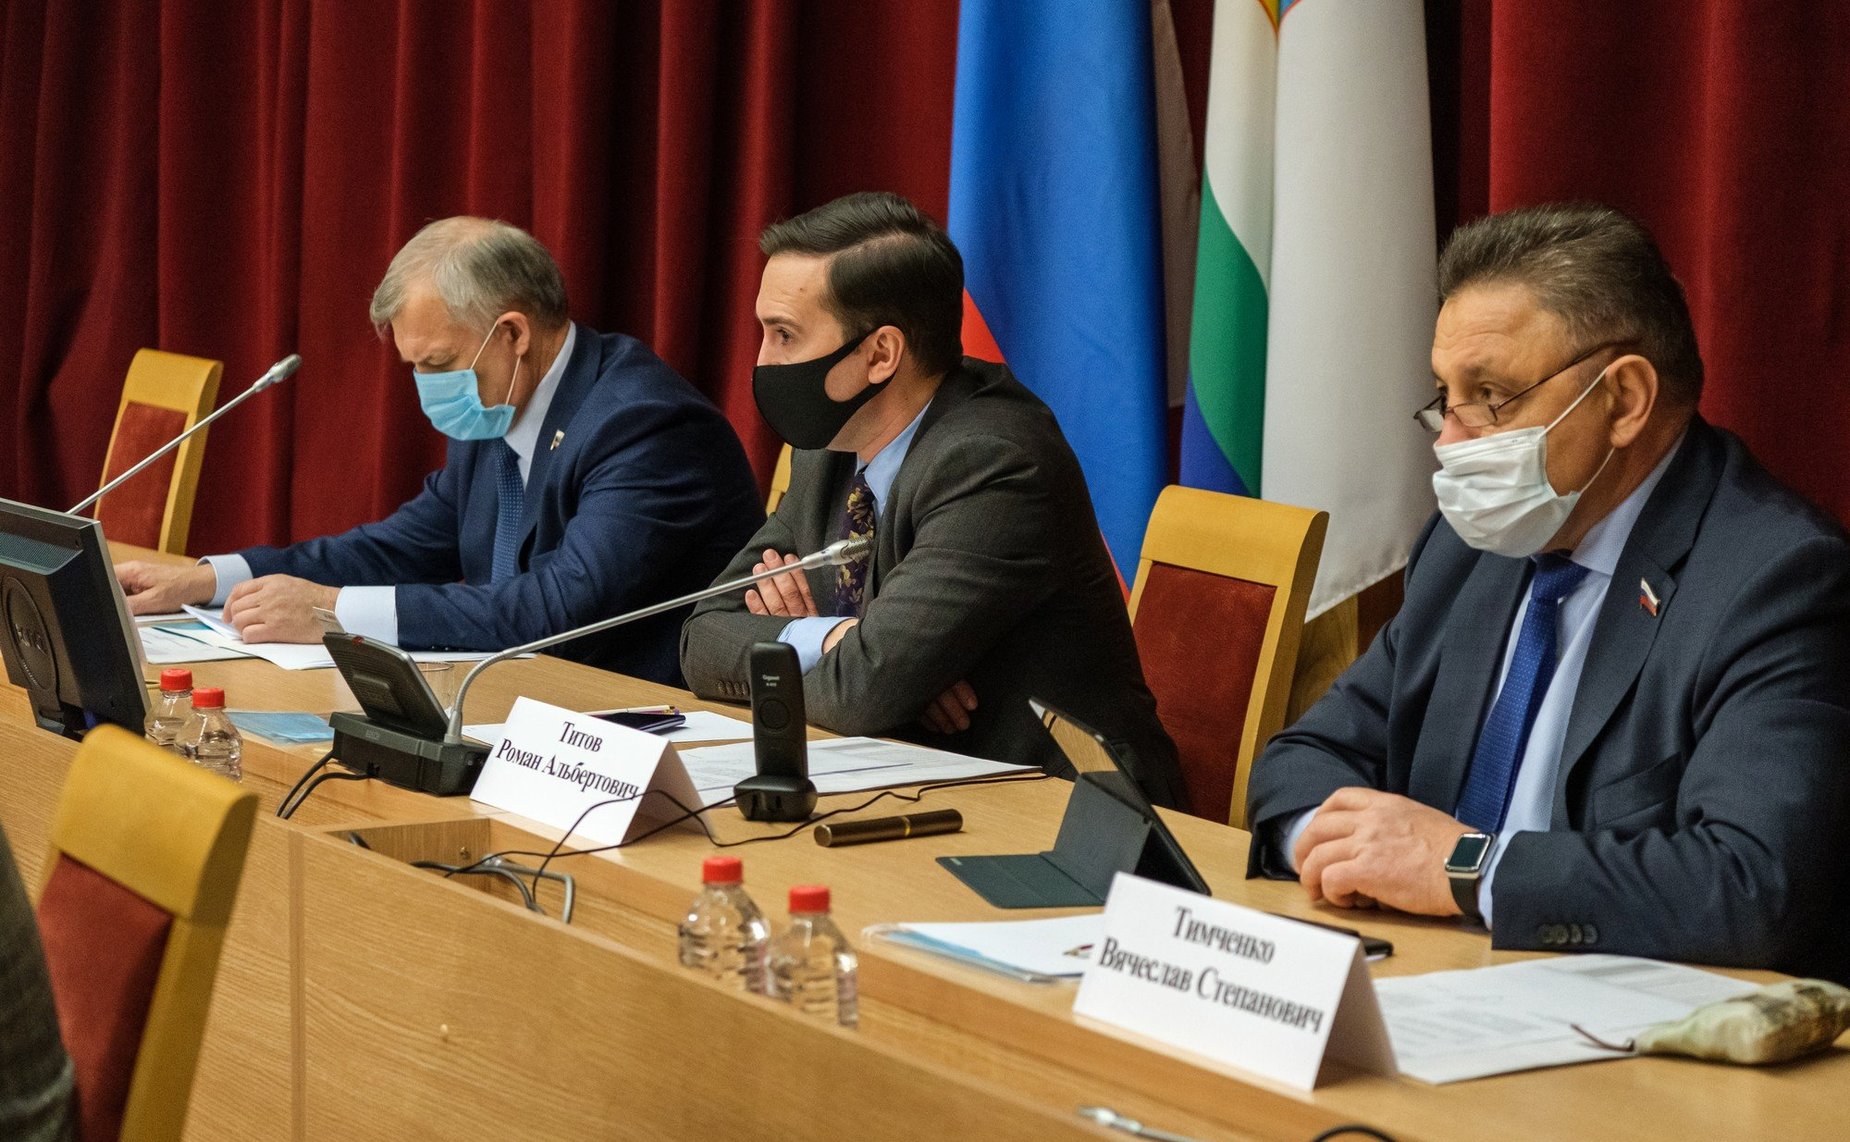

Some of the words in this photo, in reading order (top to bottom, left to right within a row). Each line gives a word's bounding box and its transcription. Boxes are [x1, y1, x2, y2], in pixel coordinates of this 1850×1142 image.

[558, 721, 603, 752] Титов
[496, 738, 543, 769] Роман
[542, 755, 639, 800] Альбертович
[1173, 906, 1275, 964] Тимченко
[1098, 936, 1193, 993] Вячеслав
[1196, 966, 1324, 1034] Степанович
